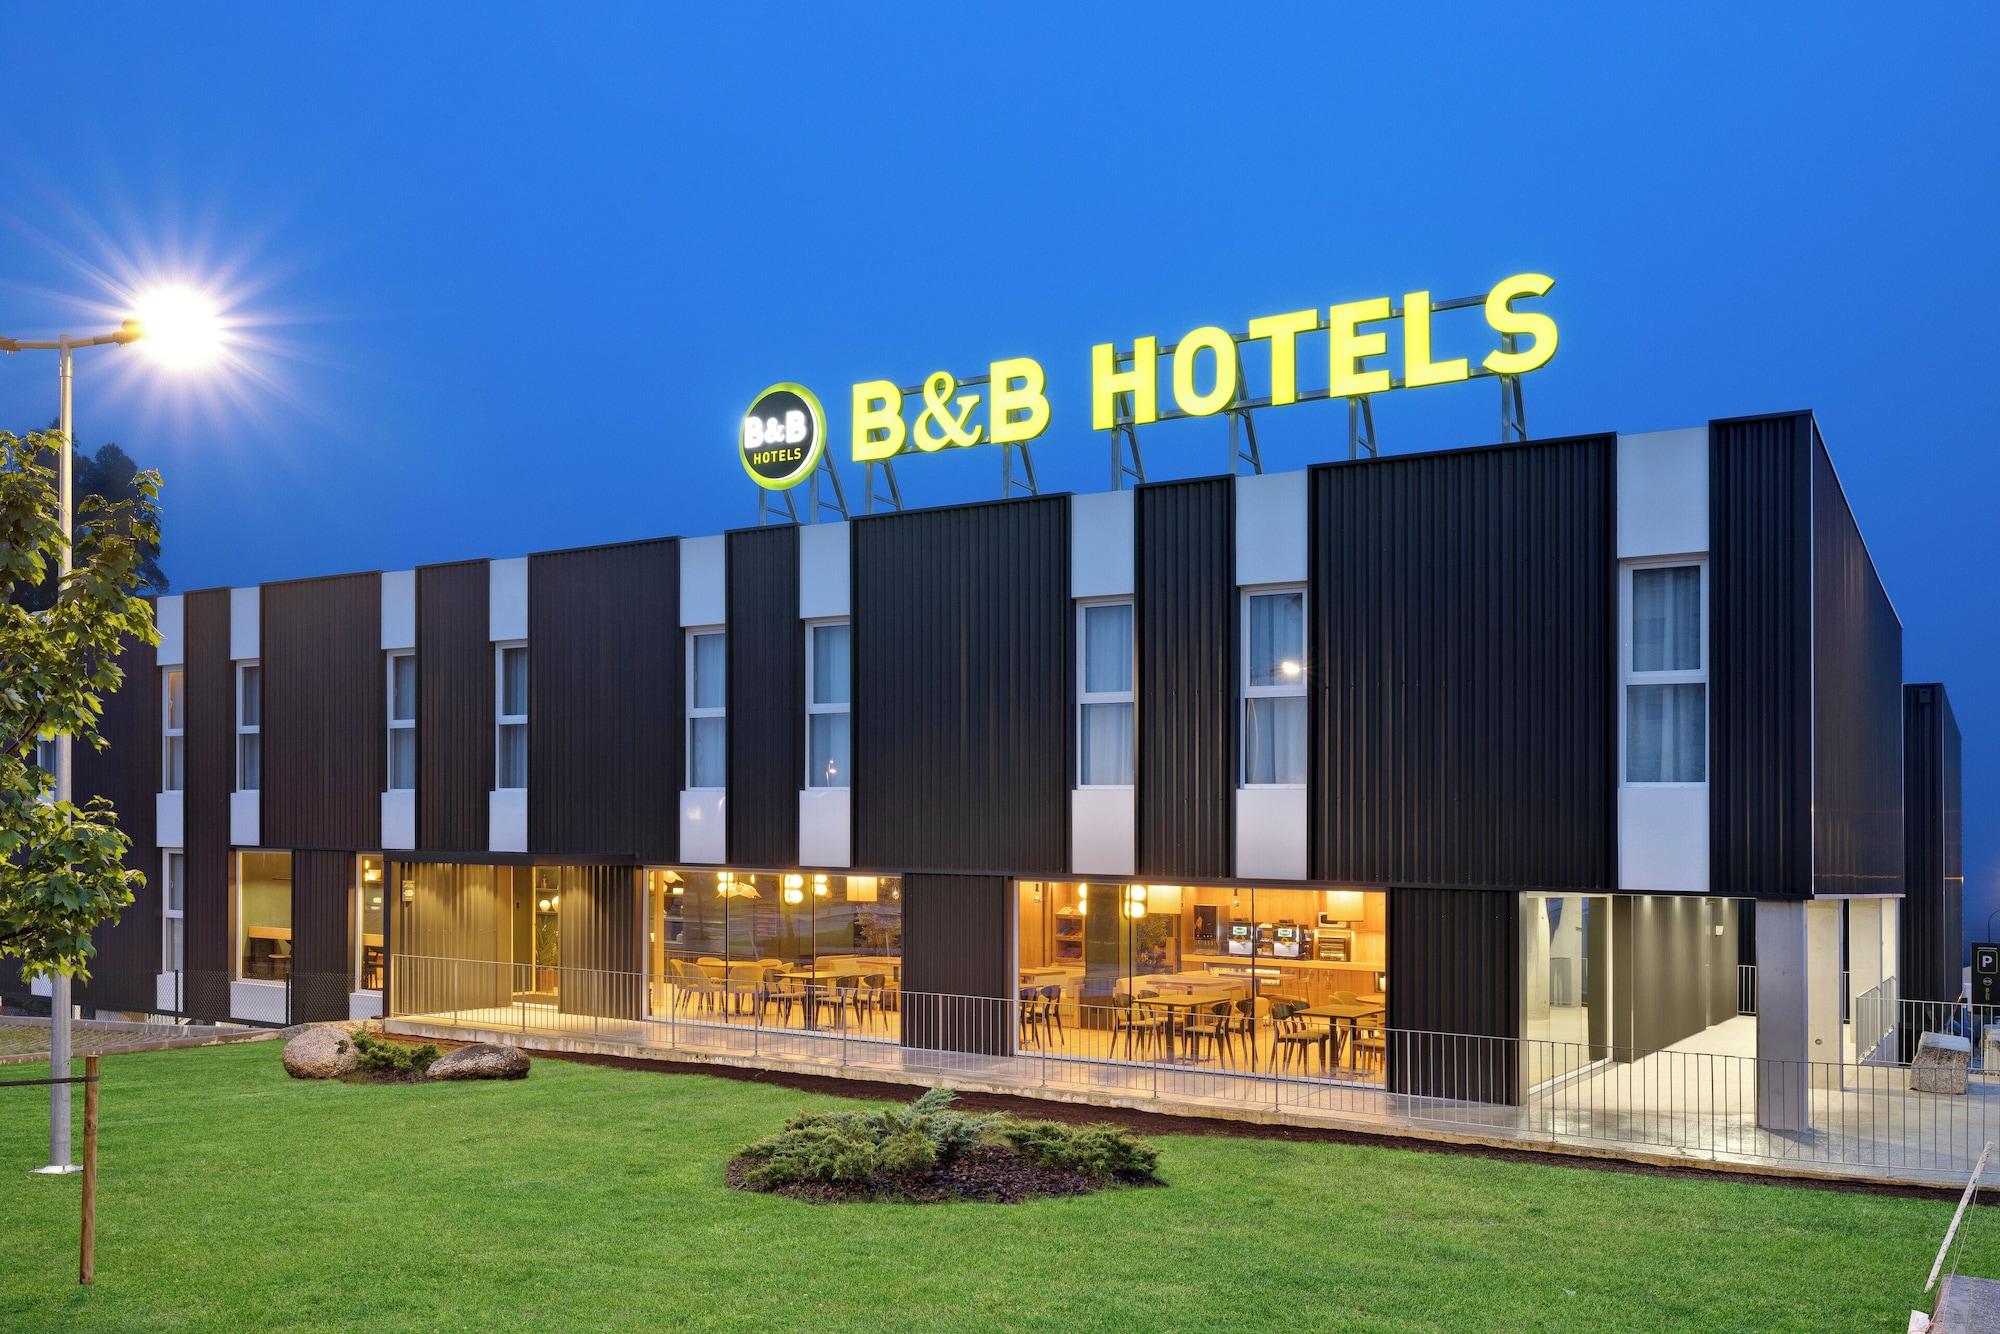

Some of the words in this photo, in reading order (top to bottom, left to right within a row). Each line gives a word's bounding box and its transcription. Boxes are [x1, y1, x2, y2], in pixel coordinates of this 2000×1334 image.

[852, 357, 1050, 462] B&B
[1092, 273, 1558, 431] HOTELS
[744, 410, 807, 449] B&B
[753, 447, 802, 465] HOTELS
[1982, 955, 1993, 968] P
